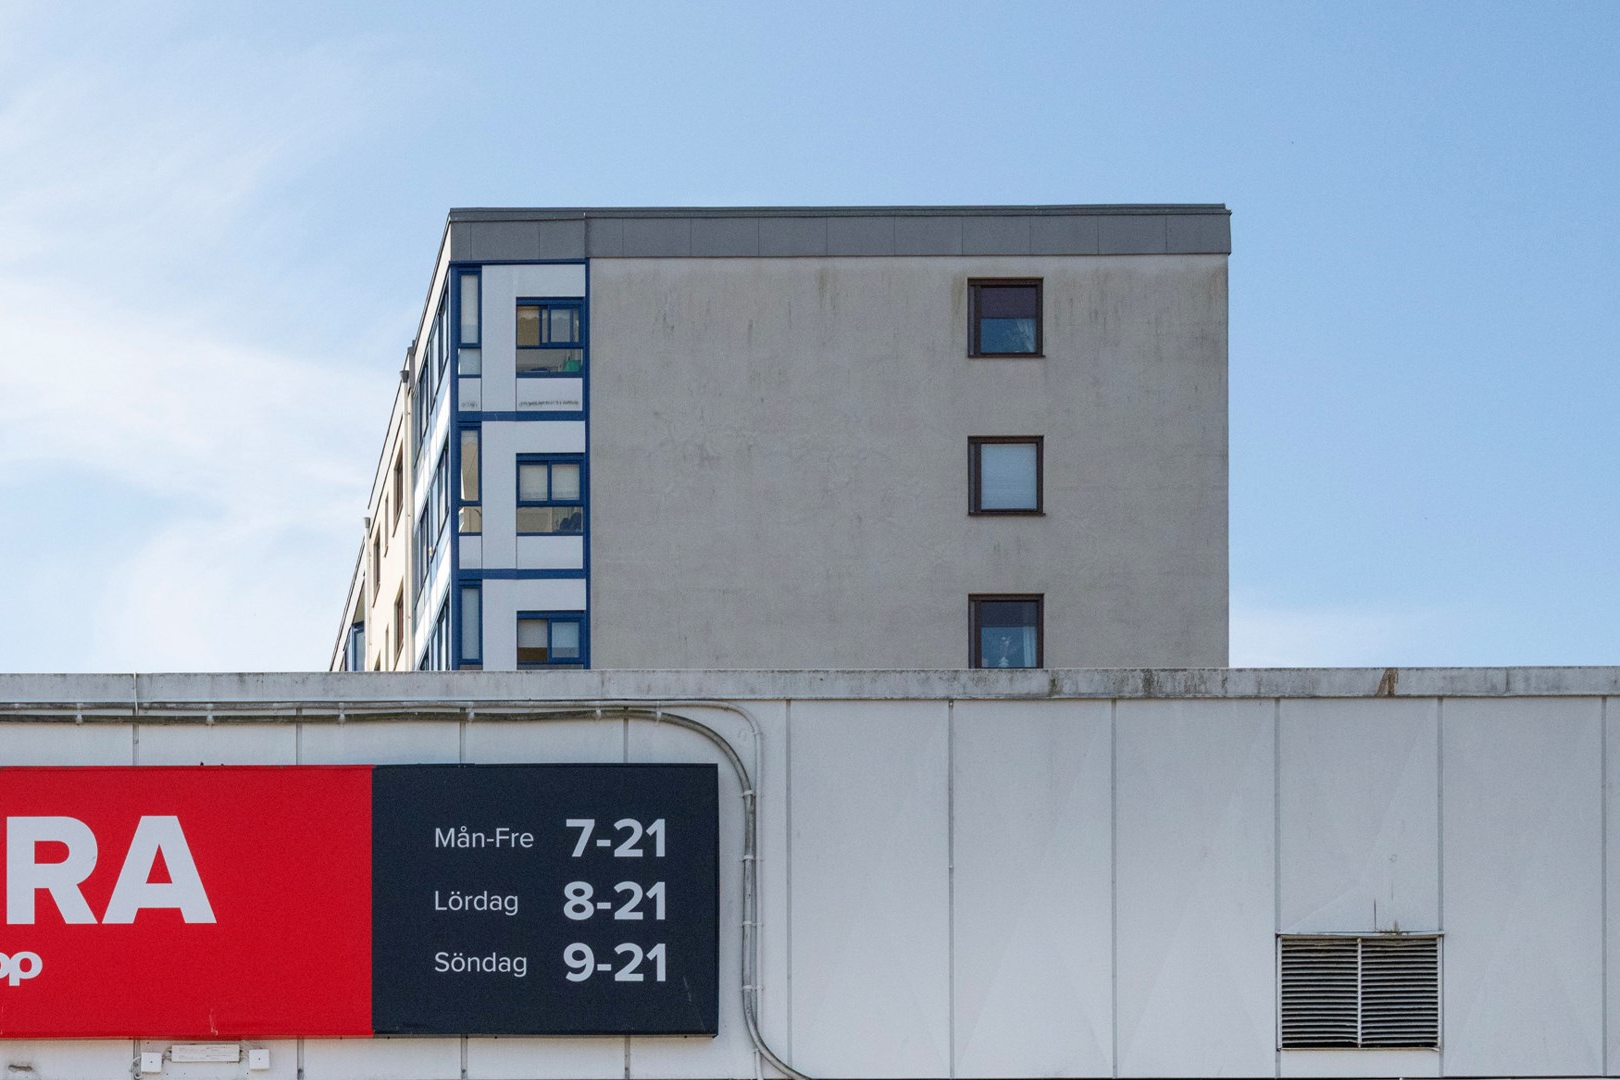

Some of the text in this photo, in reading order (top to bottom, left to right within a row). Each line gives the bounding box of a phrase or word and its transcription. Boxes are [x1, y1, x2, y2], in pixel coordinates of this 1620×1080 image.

[435, 818, 666, 857] Mån-Fre 7-21
[435, 881, 666, 921] Lördag 8-21
[435, 942, 666, 982] Söndag 9-21
